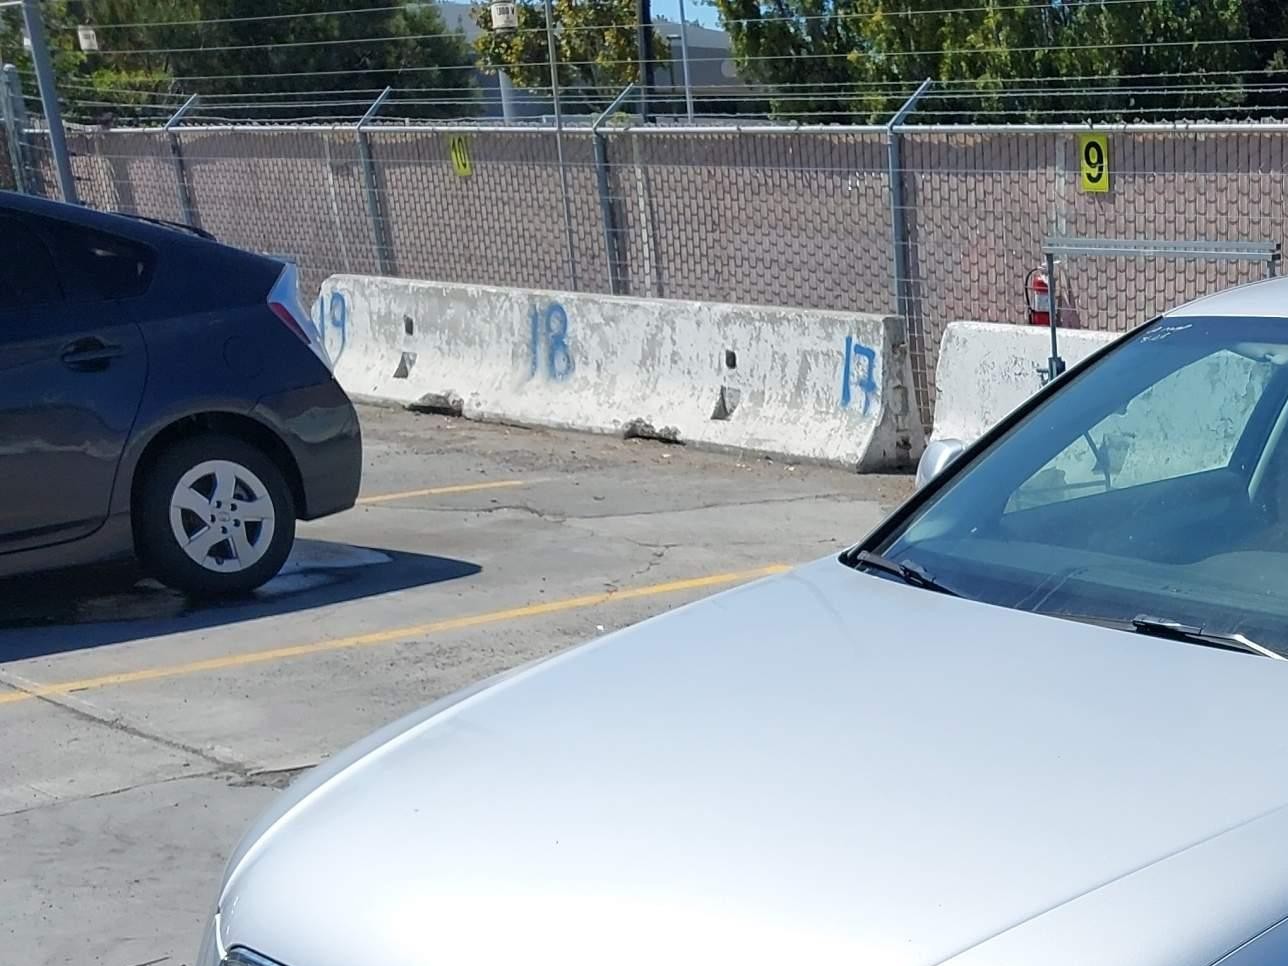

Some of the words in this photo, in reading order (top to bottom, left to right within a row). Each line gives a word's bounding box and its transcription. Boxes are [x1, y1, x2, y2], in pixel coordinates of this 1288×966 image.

[451, 136, 467, 169] 10
[1084, 140, 1104, 184] 9
[529, 302, 575, 382] 18
[841, 335, 876, 416] 17
